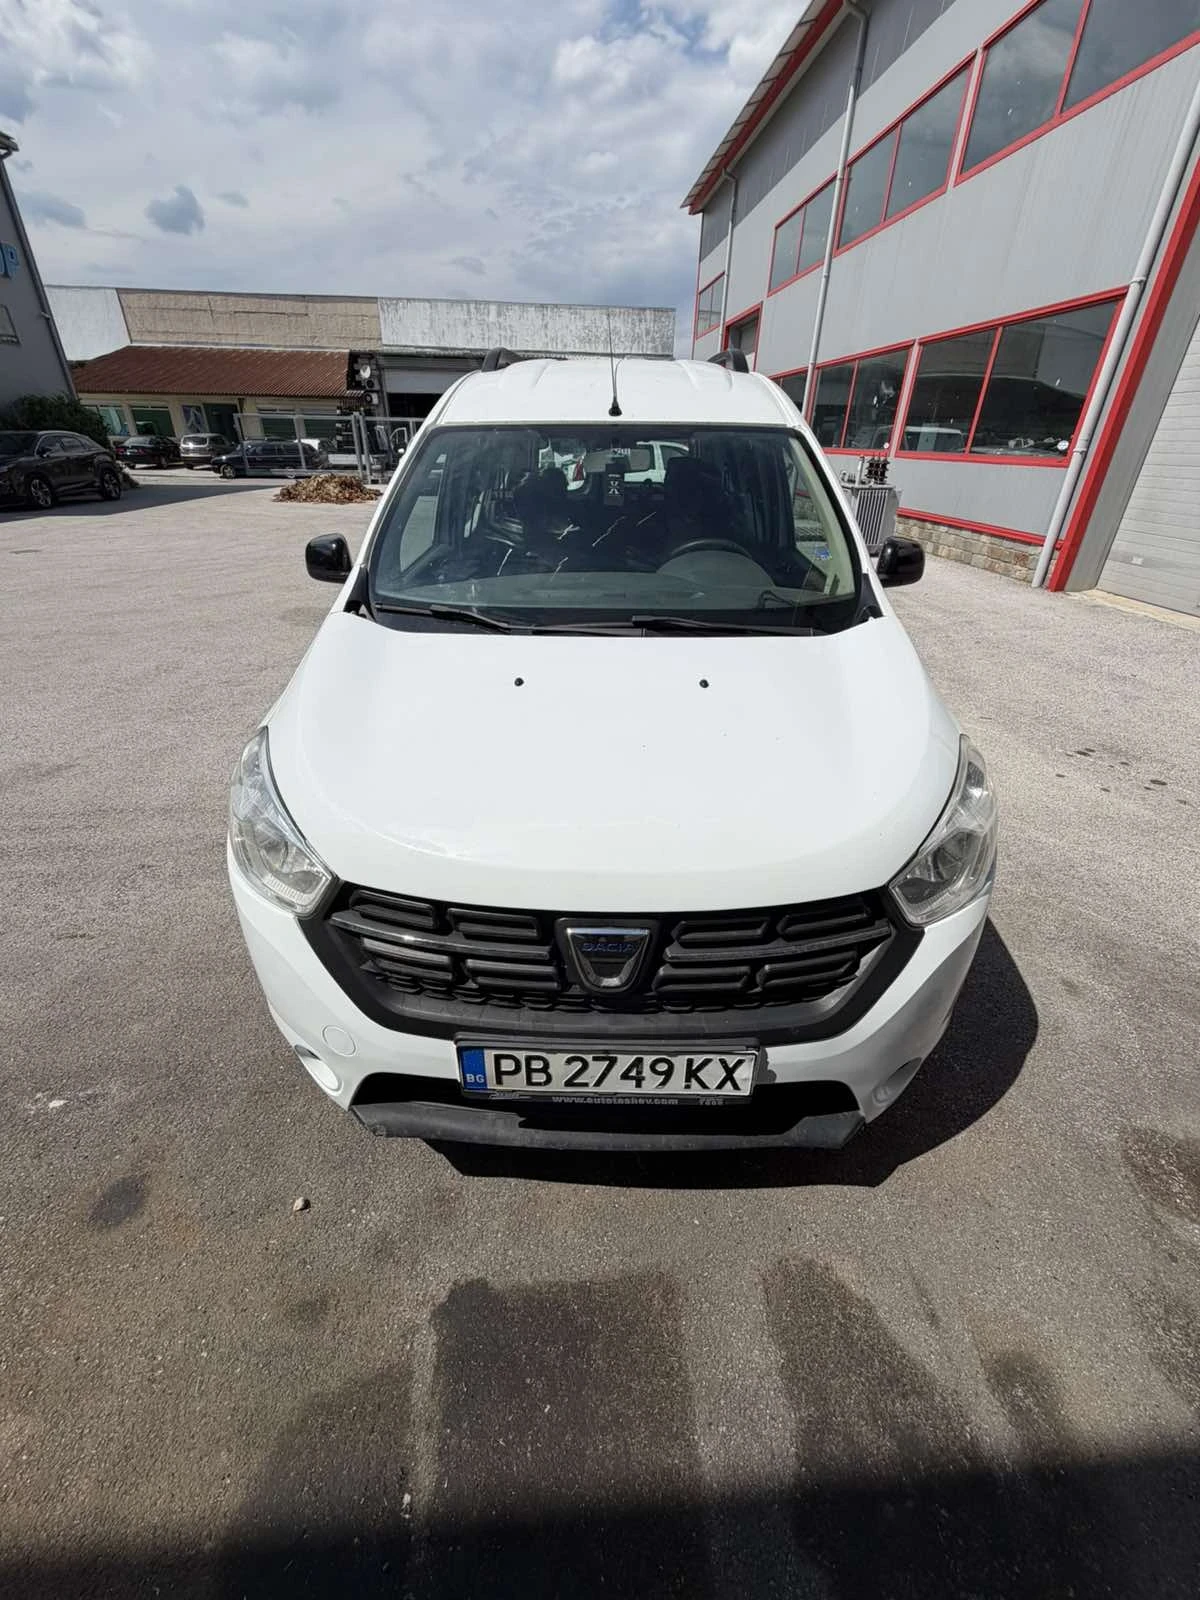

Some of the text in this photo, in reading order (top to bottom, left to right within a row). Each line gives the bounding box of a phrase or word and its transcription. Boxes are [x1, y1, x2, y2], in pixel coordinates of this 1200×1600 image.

[580, 942, 634, 953] DACIA
[493, 1053, 746, 1090] PB 2749 KX
[466, 1073, 485, 1084] BG
